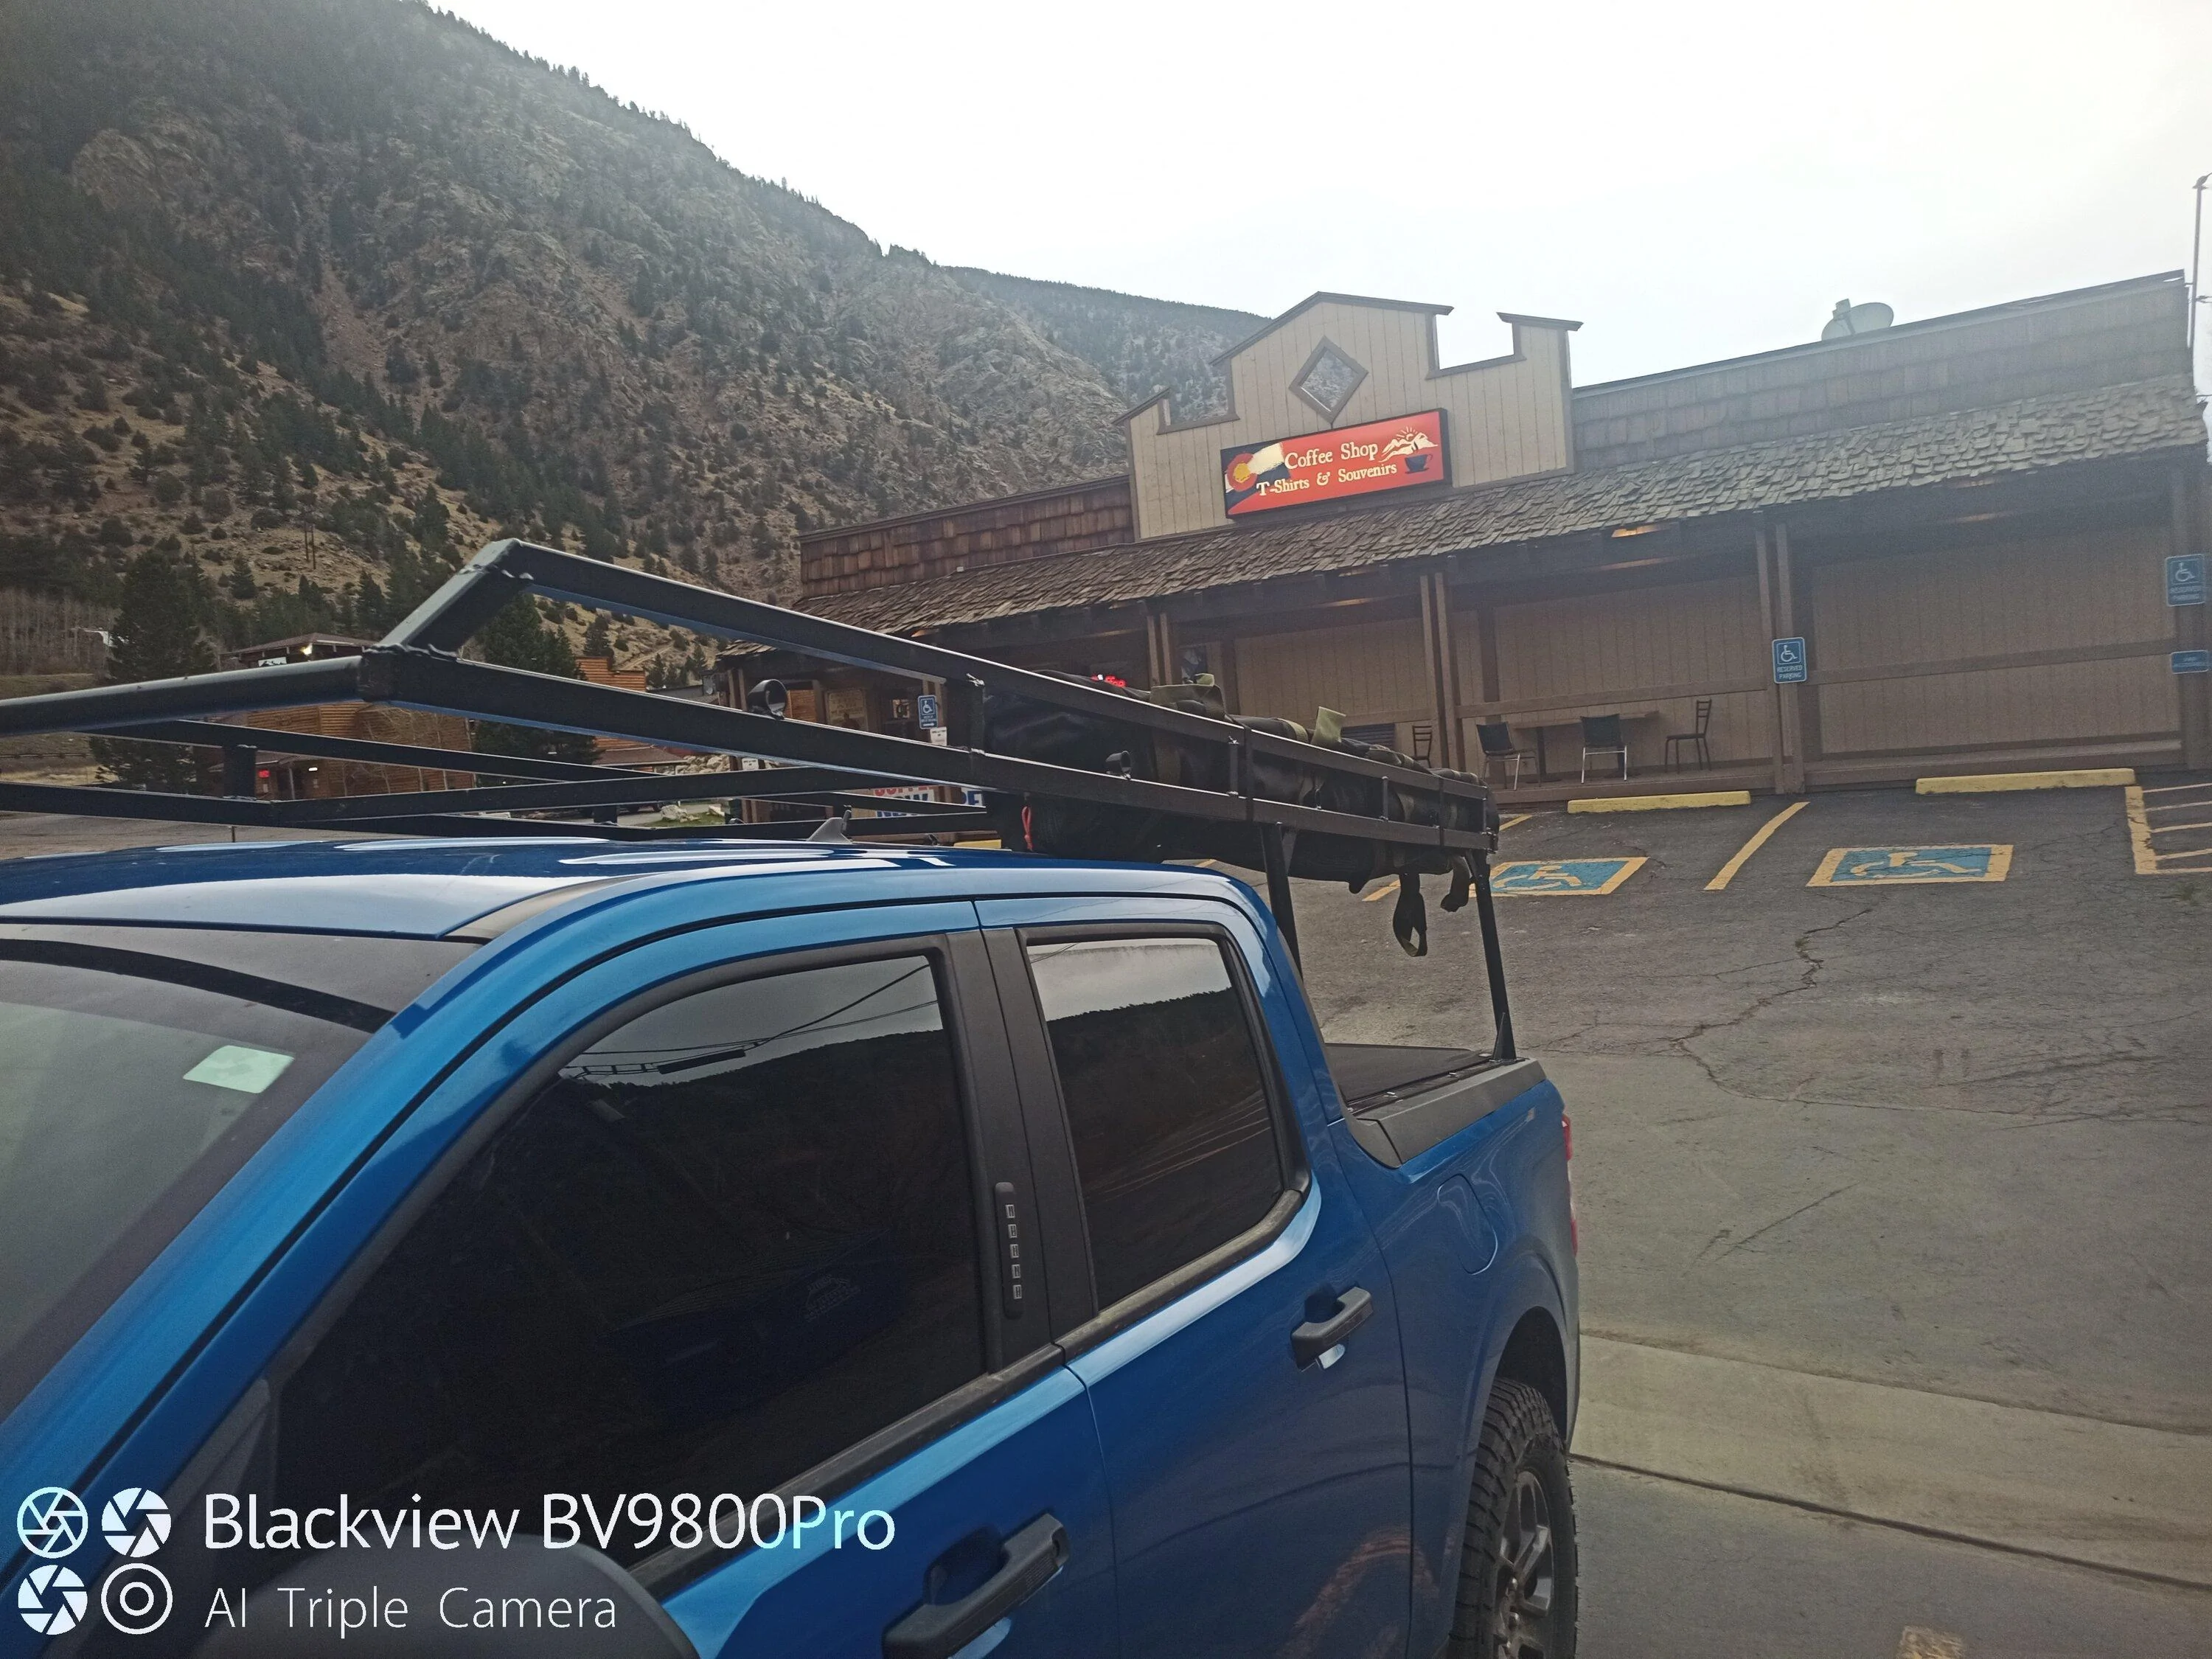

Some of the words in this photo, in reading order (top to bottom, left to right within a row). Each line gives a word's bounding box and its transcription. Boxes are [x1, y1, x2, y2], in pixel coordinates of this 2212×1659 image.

[1284, 448, 1333, 470] Coffee
[1340, 442, 1378, 462] Shop
[1256, 476, 1310, 496] T-Shirts
[1316, 472, 1331, 486] &
[1338, 463, 1397, 483] Souvenirs
